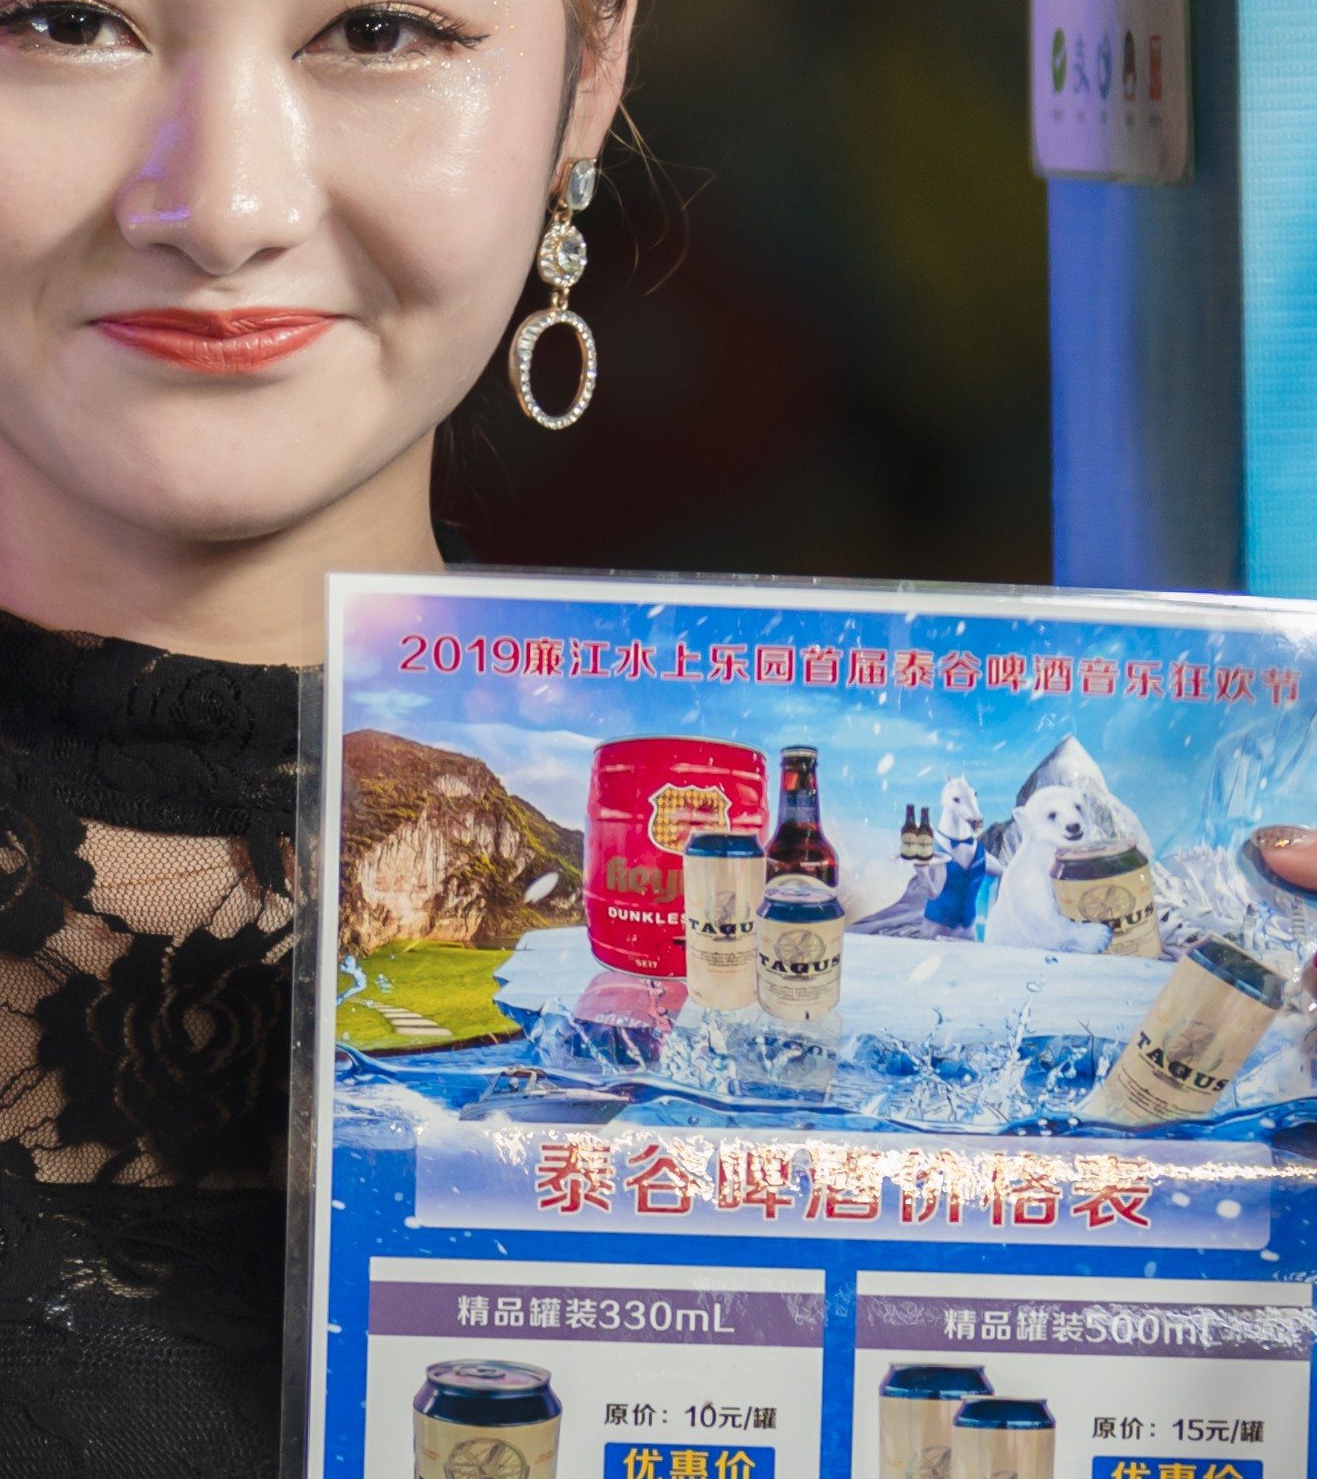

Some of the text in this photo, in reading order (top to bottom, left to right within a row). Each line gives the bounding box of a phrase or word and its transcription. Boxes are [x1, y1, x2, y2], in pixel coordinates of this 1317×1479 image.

[398, 633, 1303, 708] 2019廉江水上乐园首届泰谷啤酒音乐狂欢节
[688, 918, 754, 935] TAGU
[759, 953, 841, 972] TAGUS
[1136, 1030, 1229, 1092] TAGUS
[535, 1142, 1154, 1228] 泰谷啤酒价格表
[457, 1295, 735, 1334] 精品罐装330mL
[944, 1308, 1221, 1346] 精品罐装500mL
